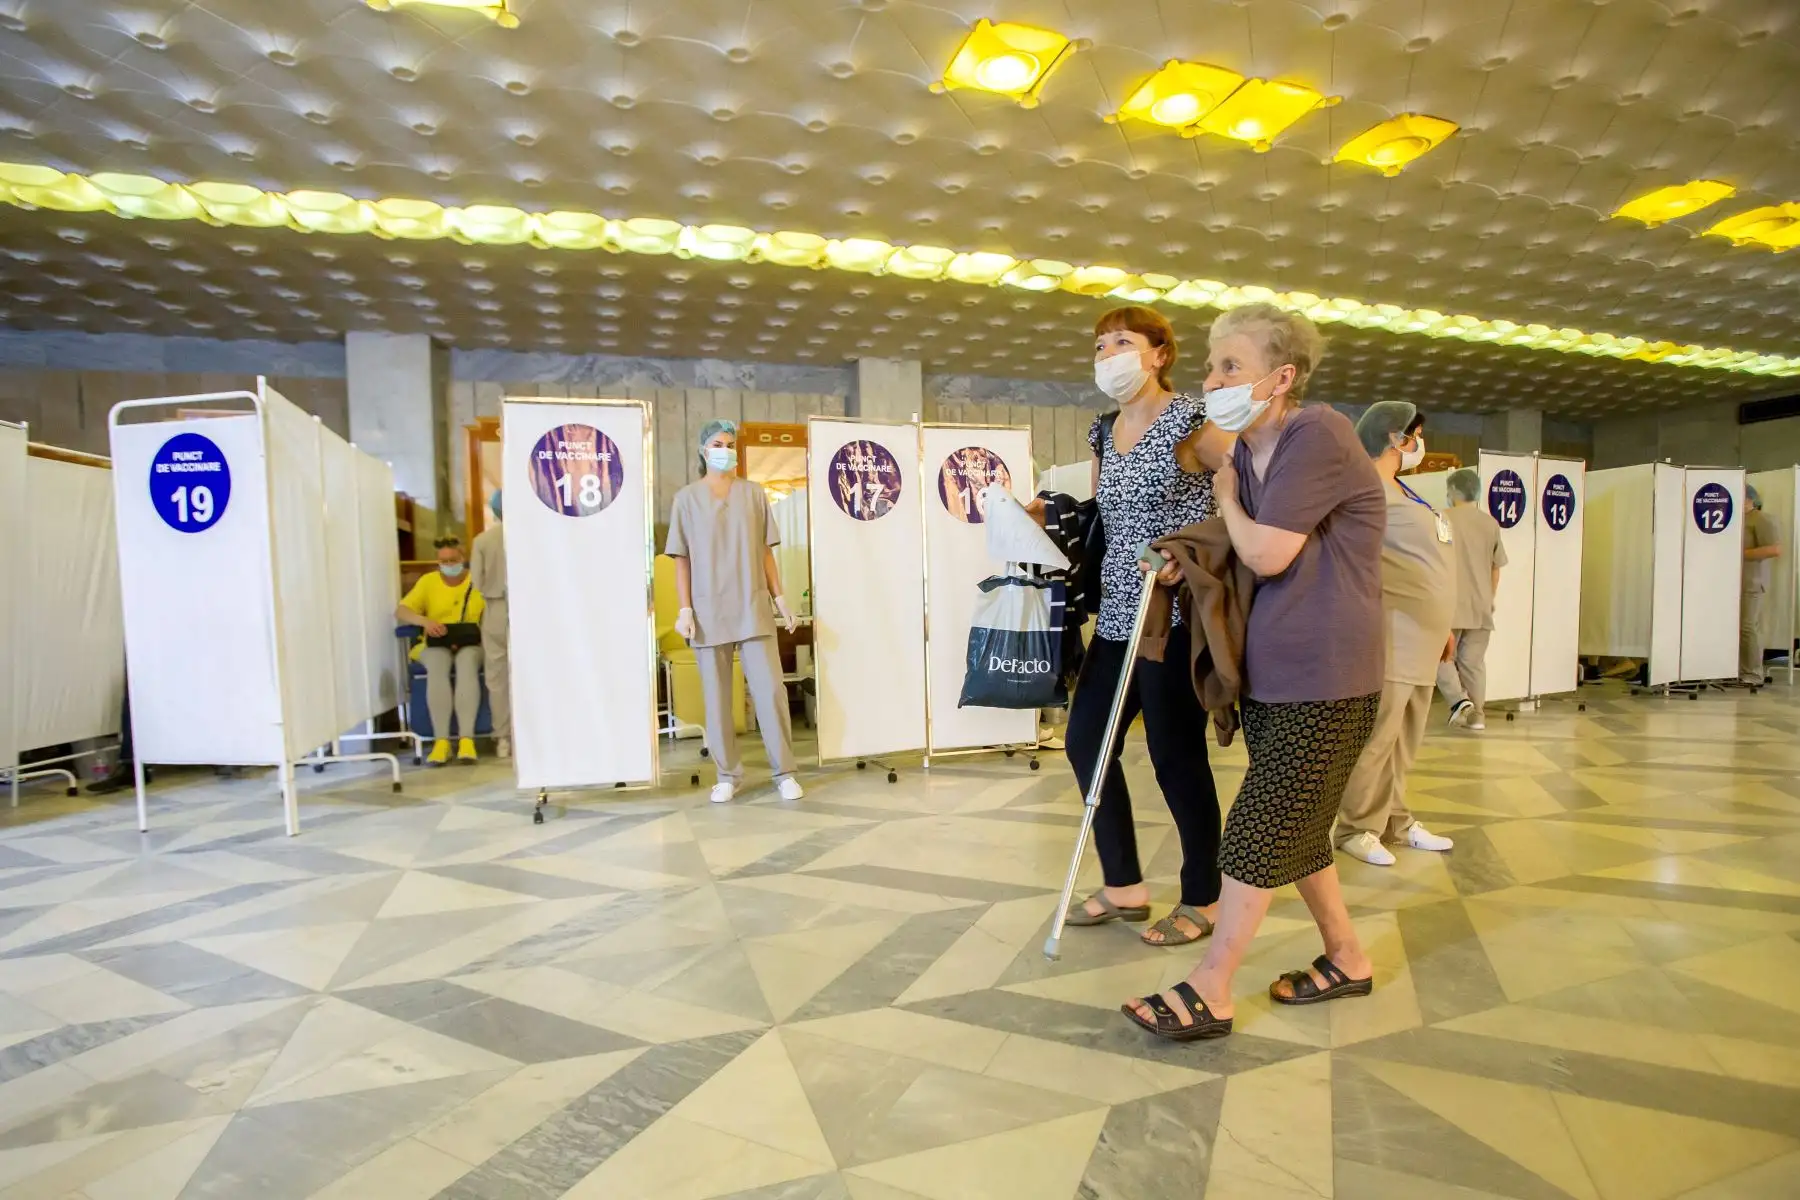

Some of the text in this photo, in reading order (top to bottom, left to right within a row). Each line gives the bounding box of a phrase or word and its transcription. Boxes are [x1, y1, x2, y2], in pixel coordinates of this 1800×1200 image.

[558, 441, 592, 450] PUNCT
[172, 451, 203, 461] PUNCT
[538, 451, 611, 461] DE VACCINARE
[851, 455, 876, 463] PUNCT
[156, 462, 221, 473] DE VACCINARE
[836, 462, 891, 472] DE VACCINARE
[958, 469, 1000, 477] VACCINARE
[555, 474, 602, 507] 18
[849, 483, 884, 511] 17
[171, 485, 214, 523] 19
[1498, 501, 1517, 522] 14
[1551, 504, 1567, 525] 13
[1702, 510, 1724, 529] 12
[989, 657, 1051, 673] DeFacto
